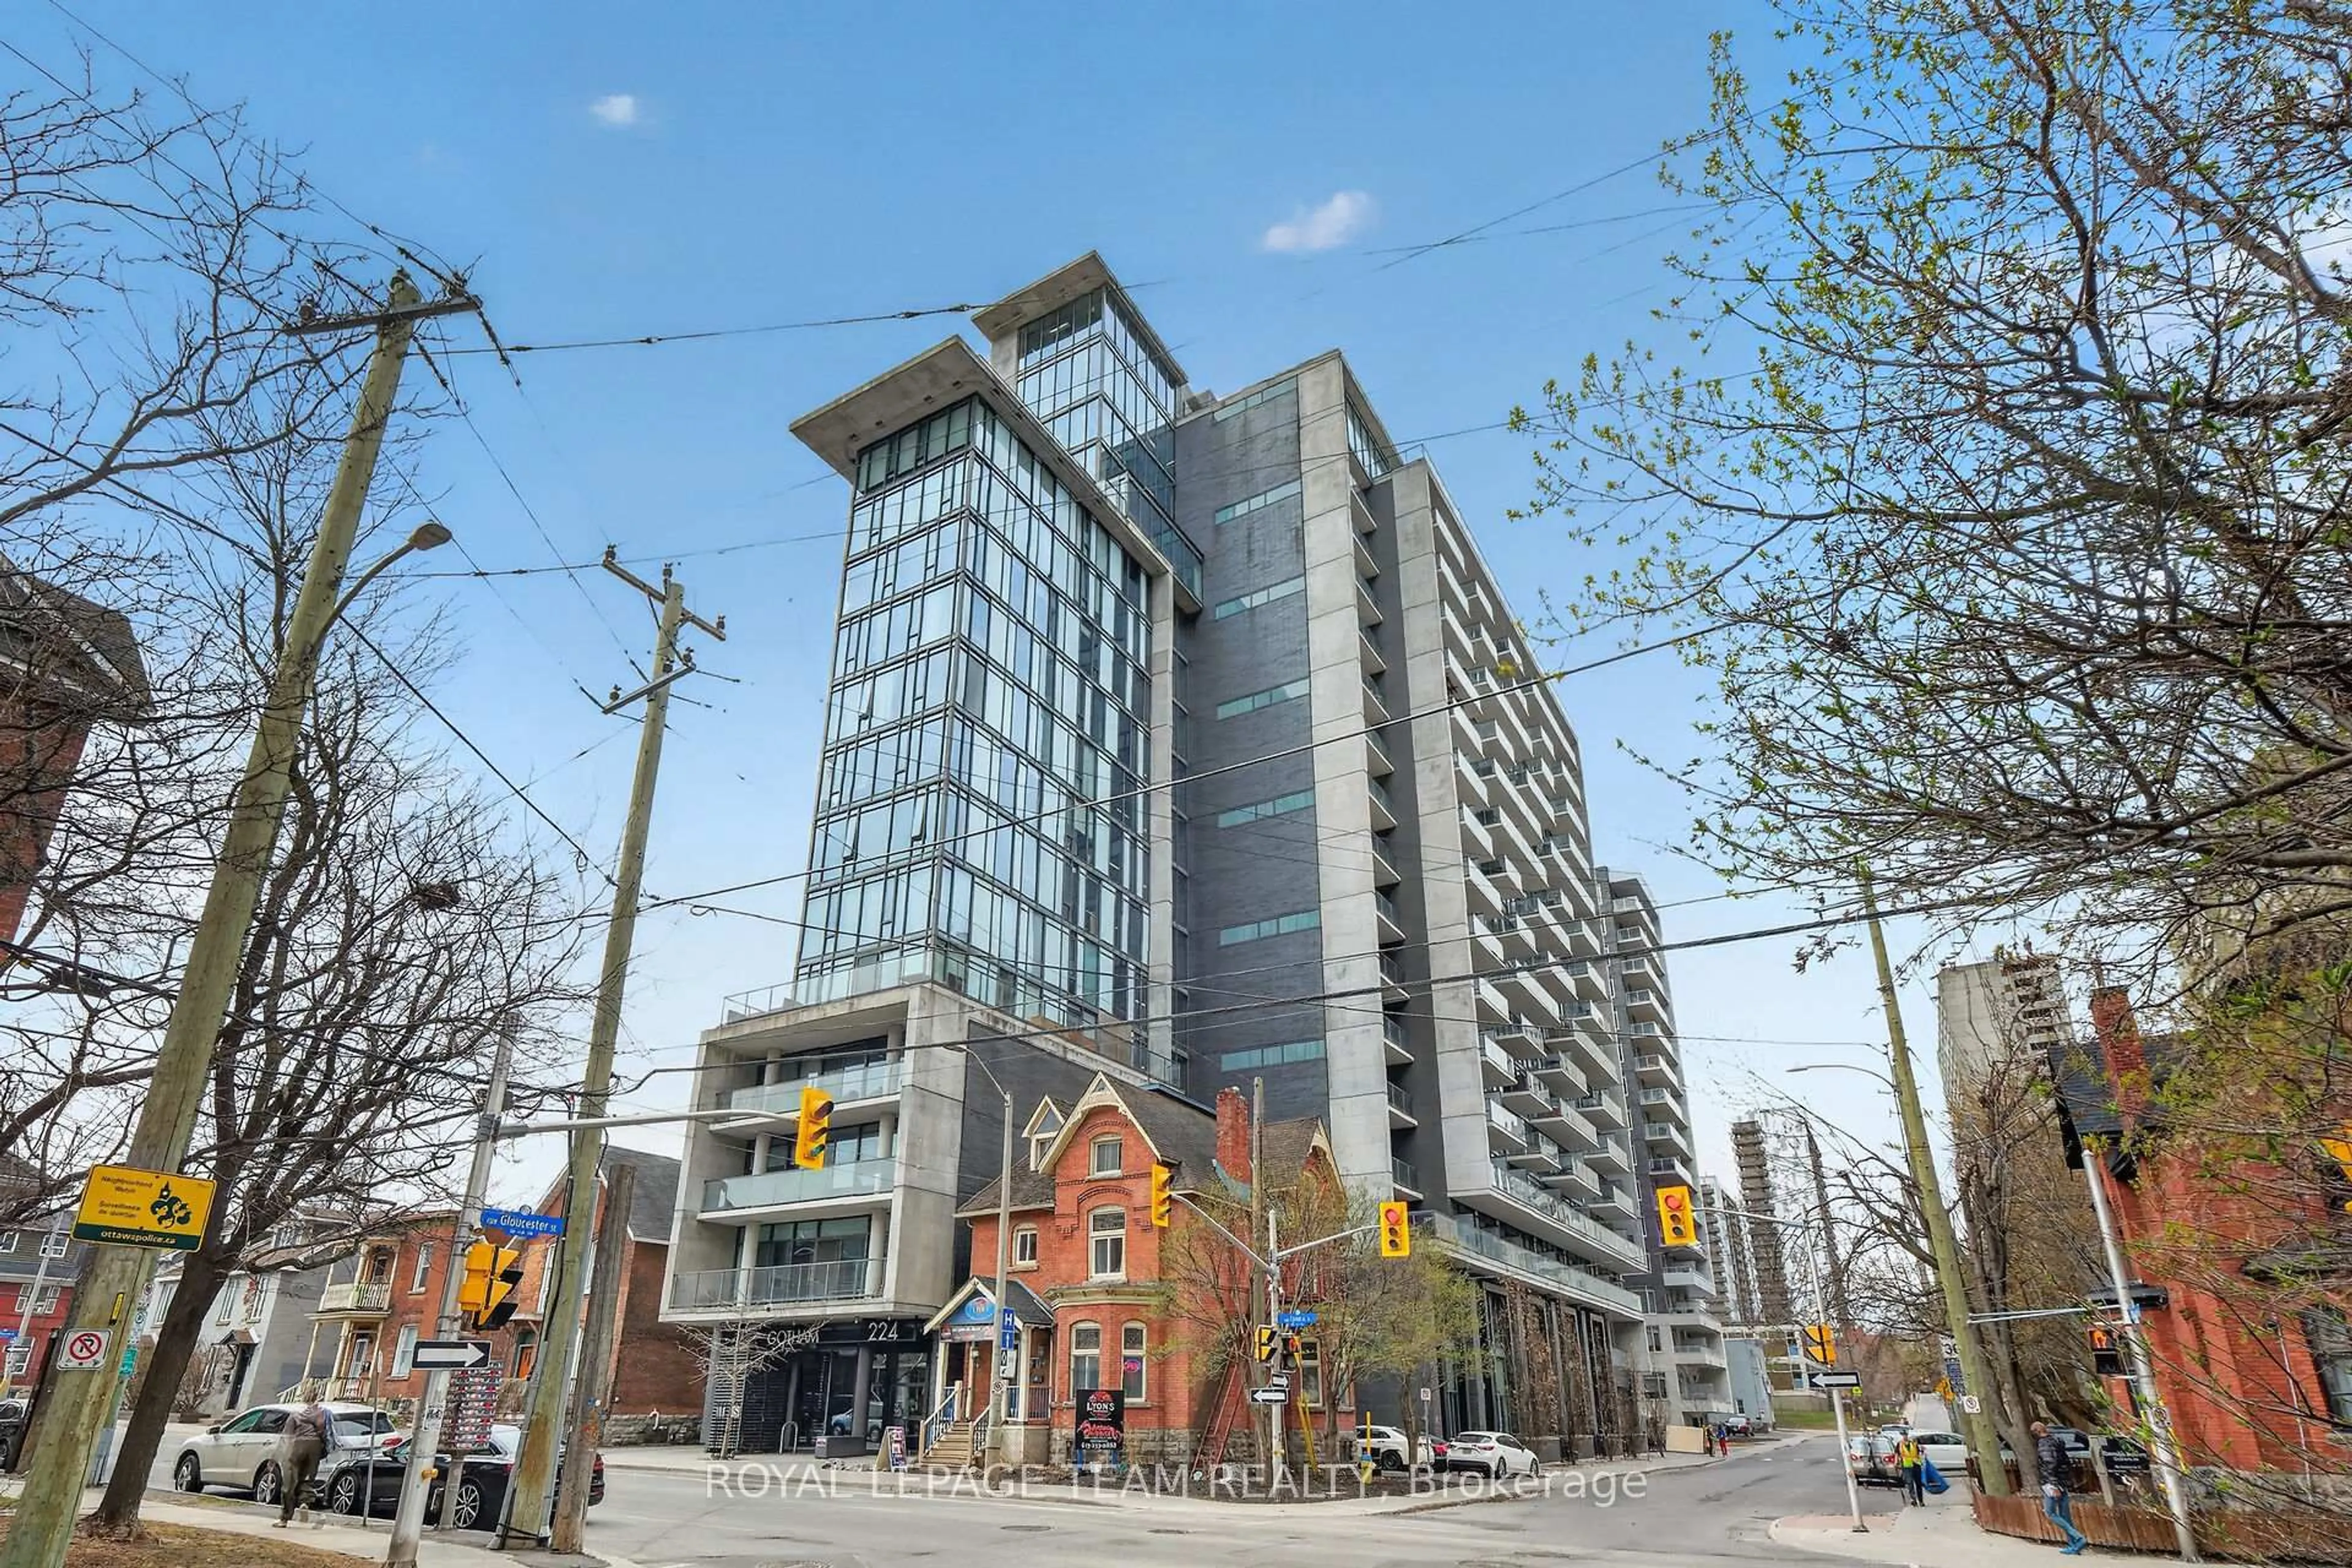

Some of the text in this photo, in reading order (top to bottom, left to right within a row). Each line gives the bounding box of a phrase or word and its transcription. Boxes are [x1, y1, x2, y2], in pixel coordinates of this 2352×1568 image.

[500, 1215, 549, 1231] Gloucester
[100, 1231, 177, 1245] ottawapolice.ca
[1005, 1313, 1013, 1325] H
[868, 1321, 899, 1341] 224
